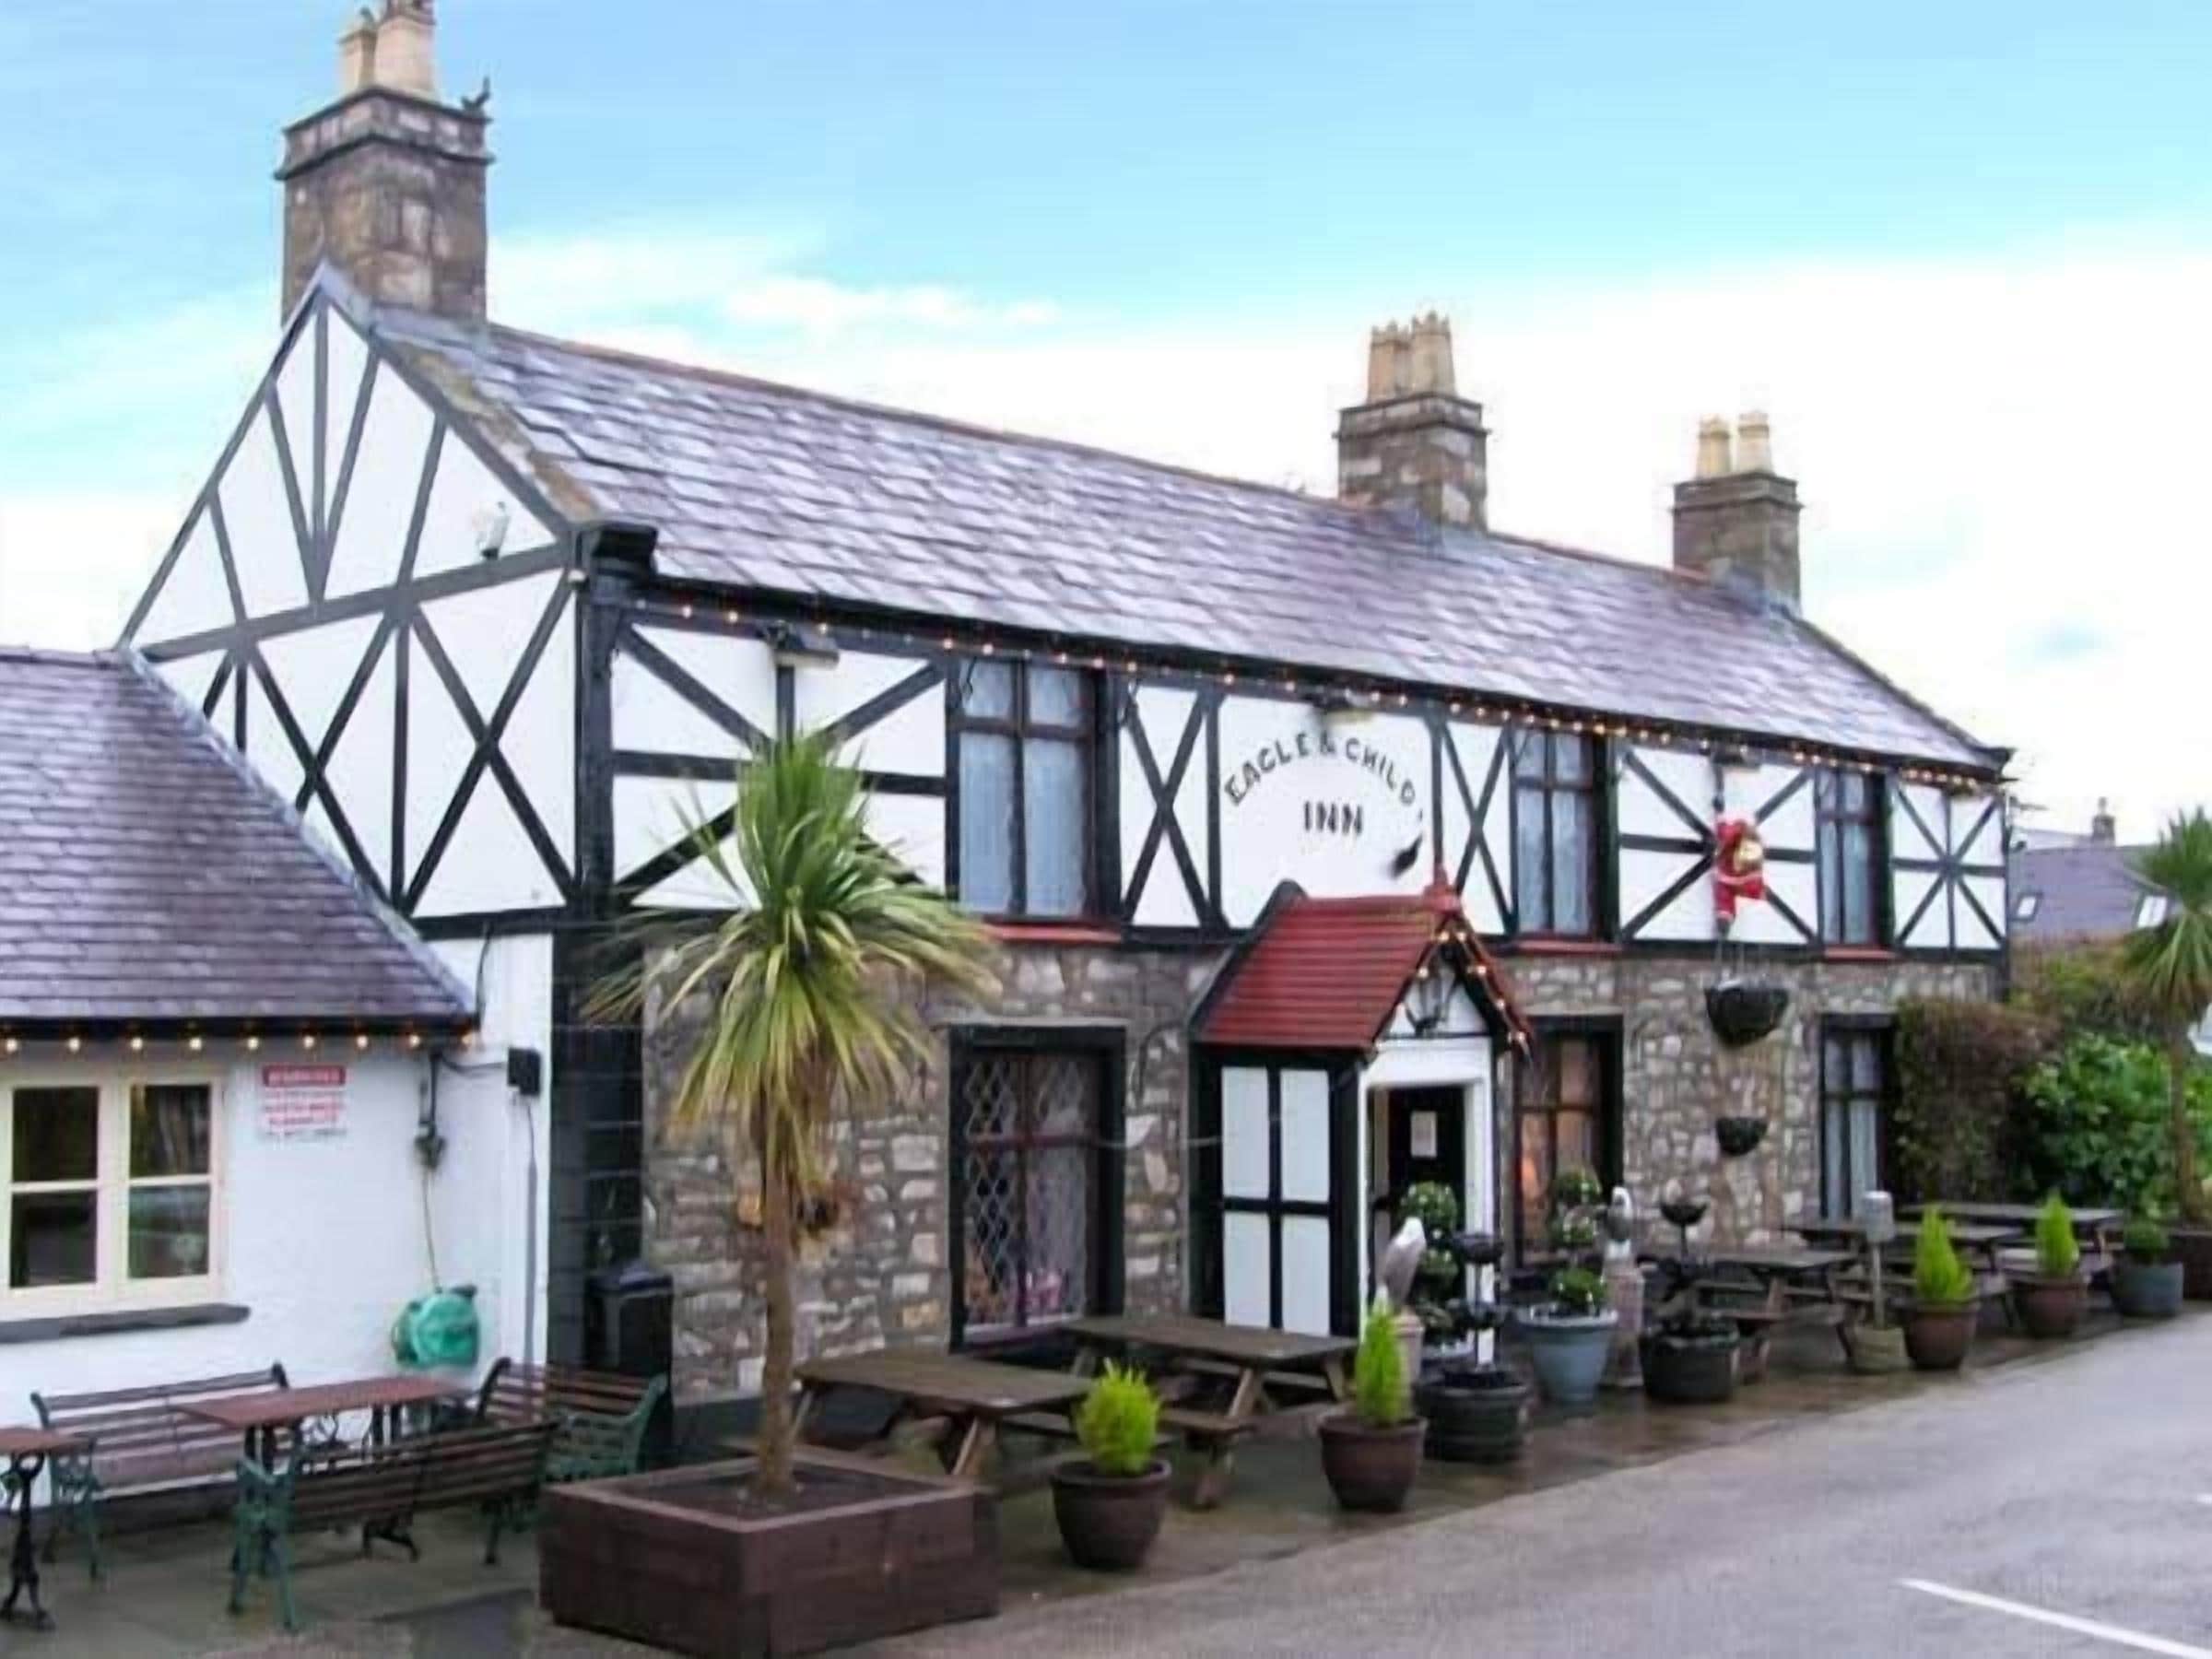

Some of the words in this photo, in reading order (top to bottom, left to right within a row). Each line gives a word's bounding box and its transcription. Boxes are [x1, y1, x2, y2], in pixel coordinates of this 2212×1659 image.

[1224, 733, 1309, 806] EAGLE
[1345, 737, 1416, 805] CHILD
[1302, 800, 1363, 835] INN
